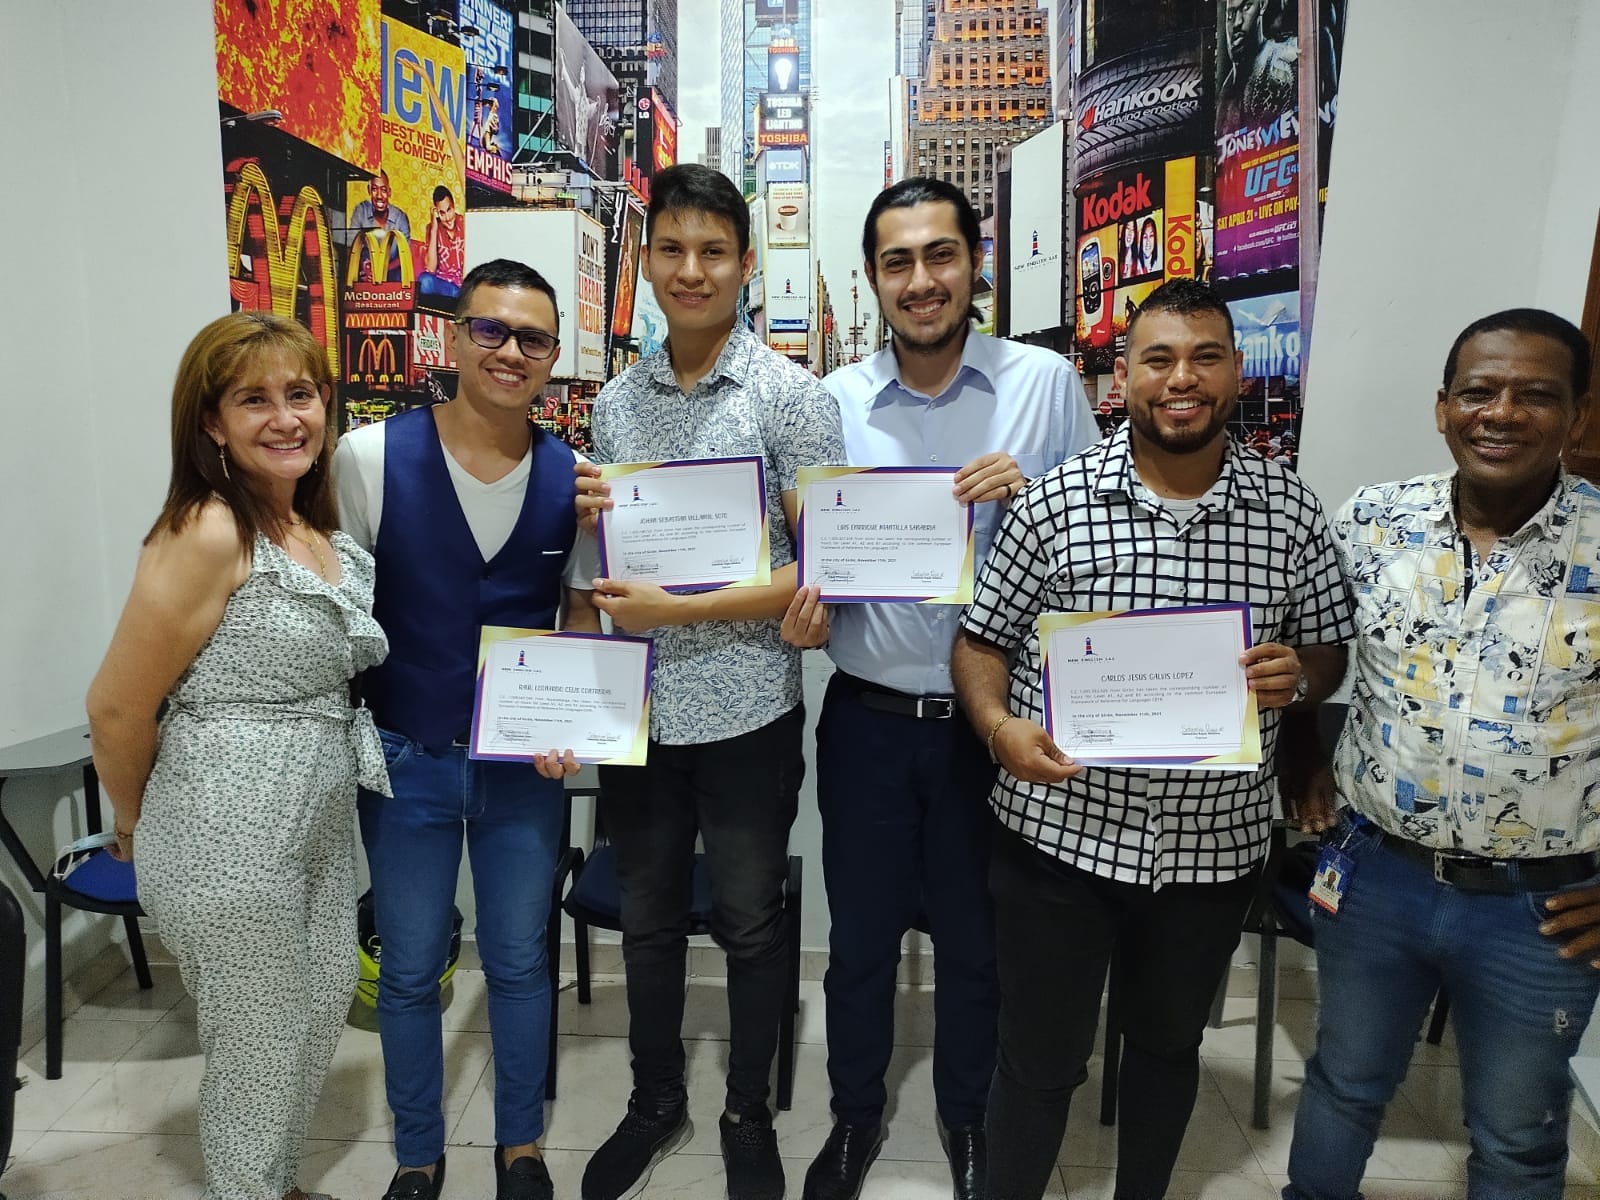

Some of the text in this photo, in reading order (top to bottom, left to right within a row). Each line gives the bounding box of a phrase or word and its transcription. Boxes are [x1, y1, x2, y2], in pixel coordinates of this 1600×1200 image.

[459, 0, 511, 32] NNER!
[1106, 99, 1199, 127] driving emotion
[382, 120, 445, 151] BEST NEW
[760, 134, 808, 143] TOSHIBA
[467, 147, 512, 185] EMPHIS
[775, 162, 799, 170] TDK
[1244, 155, 1295, 197] UFC
[1083, 173, 1151, 230] Kodak
[1217, 216, 1228, 231] SAT
[1228, 211, 1246, 228] APRIL
[1246, 209, 1253, 223] 21
[1259, 203, 1272, 219] LIVE
[1273, 200, 1283, 215] ON
[583, 232, 599, 262] DON'T
[1167, 214, 1192, 280] Kod
[344, 290, 411, 301] McDonald's
[1101, 674, 1125, 682] CARLOS
[1128, 673, 1147, 681] JESUS
